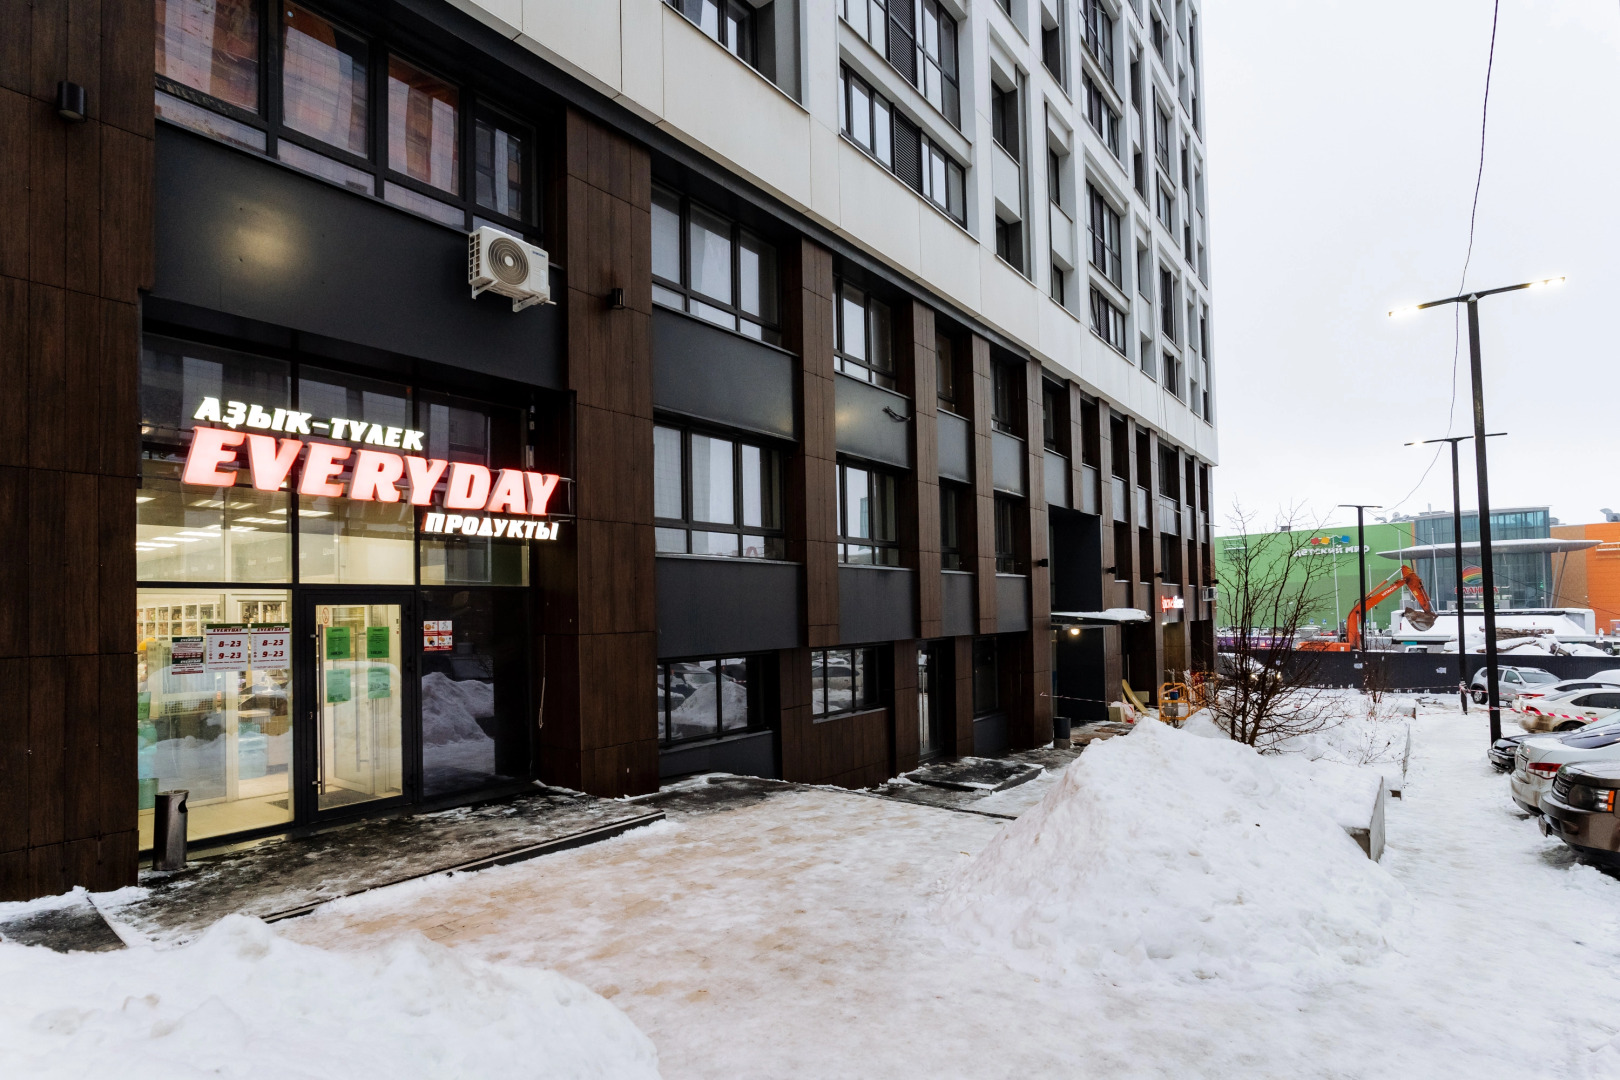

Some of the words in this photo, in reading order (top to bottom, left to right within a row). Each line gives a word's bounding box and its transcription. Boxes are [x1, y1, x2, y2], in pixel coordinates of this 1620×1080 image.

[181, 425, 560, 516] EVERYDAY
[422, 512, 559, 541] ПРОДУКТЫ
[1293, 544, 1343, 557] ДЕТСКИЙ
